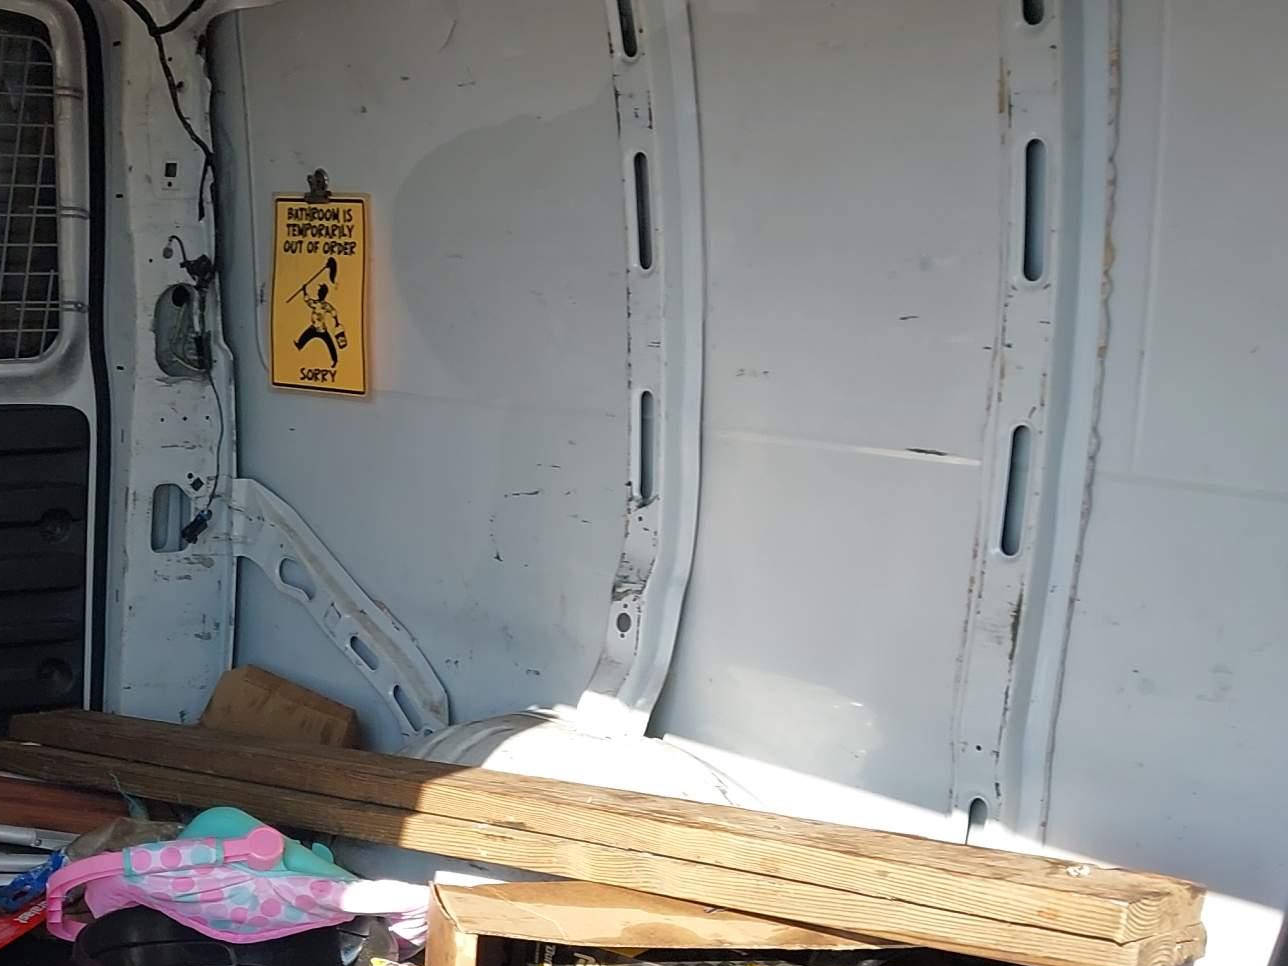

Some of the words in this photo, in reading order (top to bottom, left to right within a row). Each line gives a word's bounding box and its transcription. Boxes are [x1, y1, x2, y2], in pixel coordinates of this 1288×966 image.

[287, 207, 340, 223] BATHROOM
[342, 208, 353, 222] IS
[286, 224, 355, 238] TEMPORARILY
[283, 240, 305, 254] OUT
[307, 241, 319, 254] OF
[323, 240, 357, 256] ORDER
[299, 367, 338, 383] SORRY
